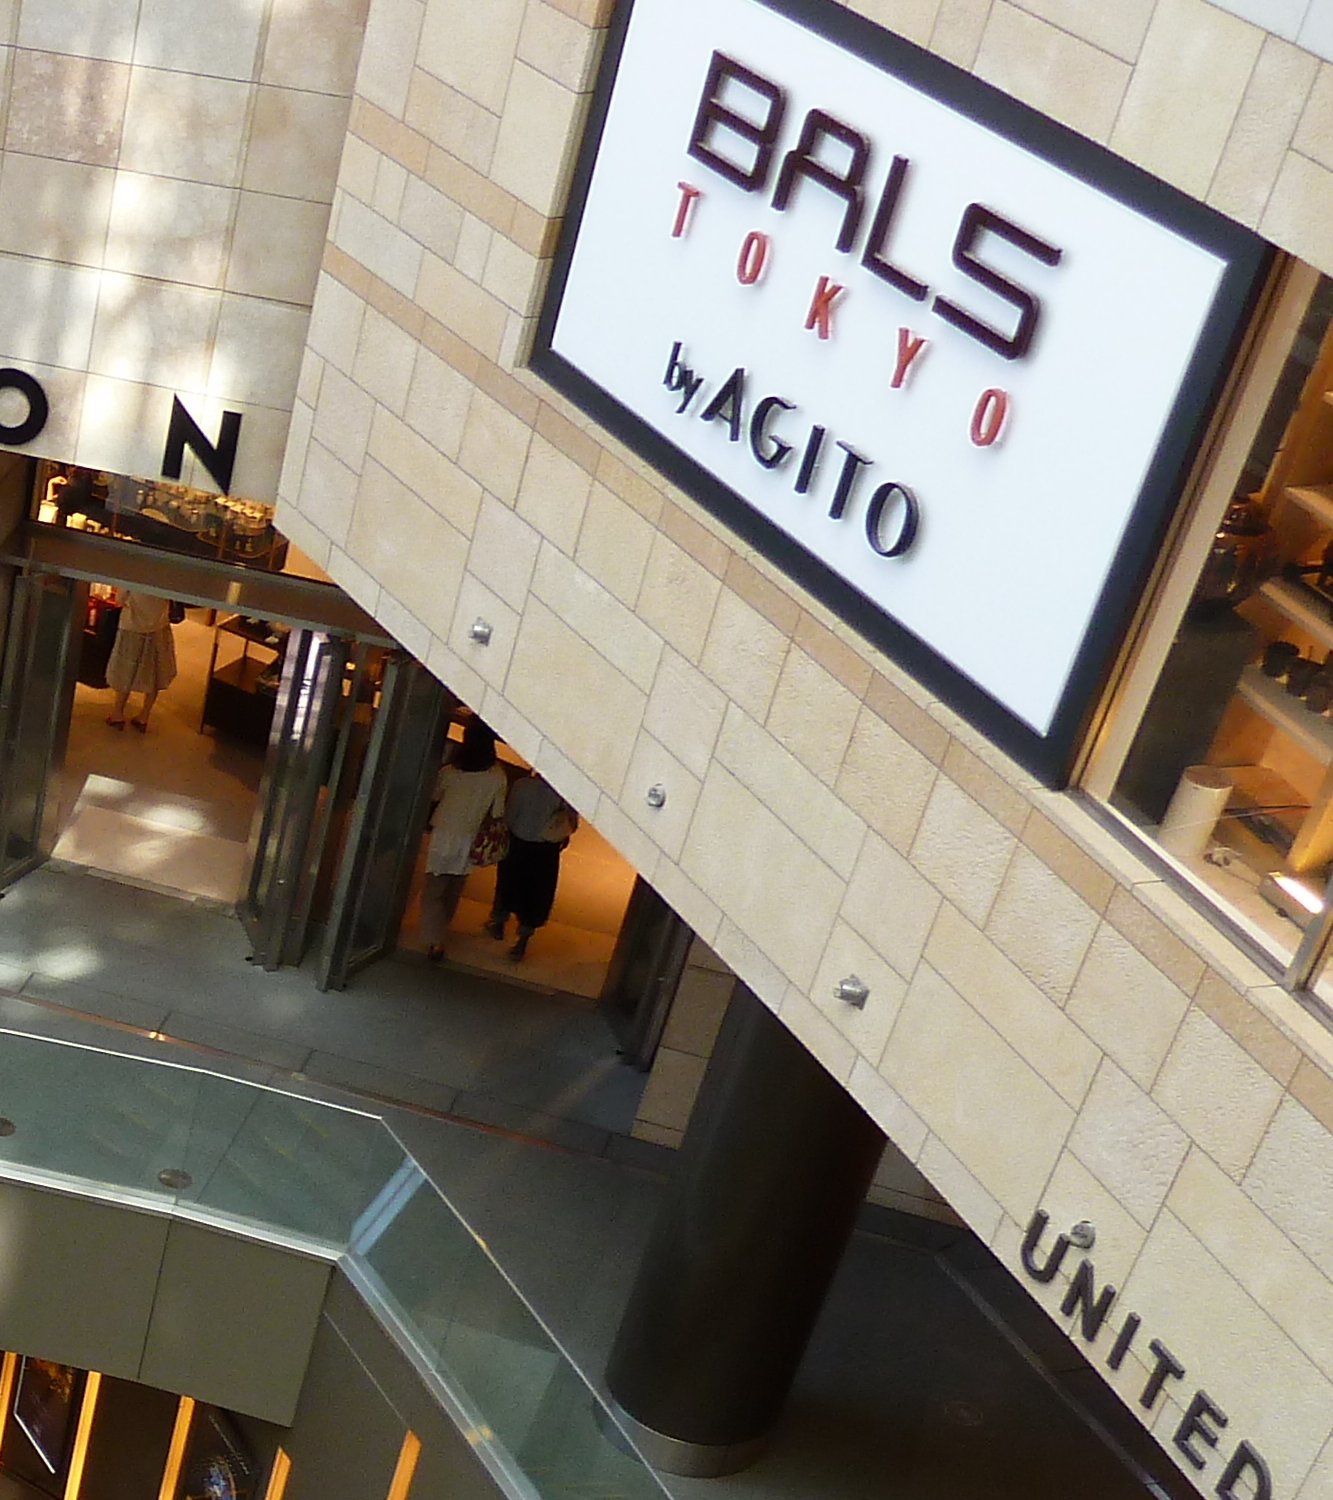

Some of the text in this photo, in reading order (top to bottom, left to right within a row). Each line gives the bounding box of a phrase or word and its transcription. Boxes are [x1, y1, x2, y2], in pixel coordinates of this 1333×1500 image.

[671, 181, 1012, 448] TOKYO
[663, 341, 921, 558] by AGITO
